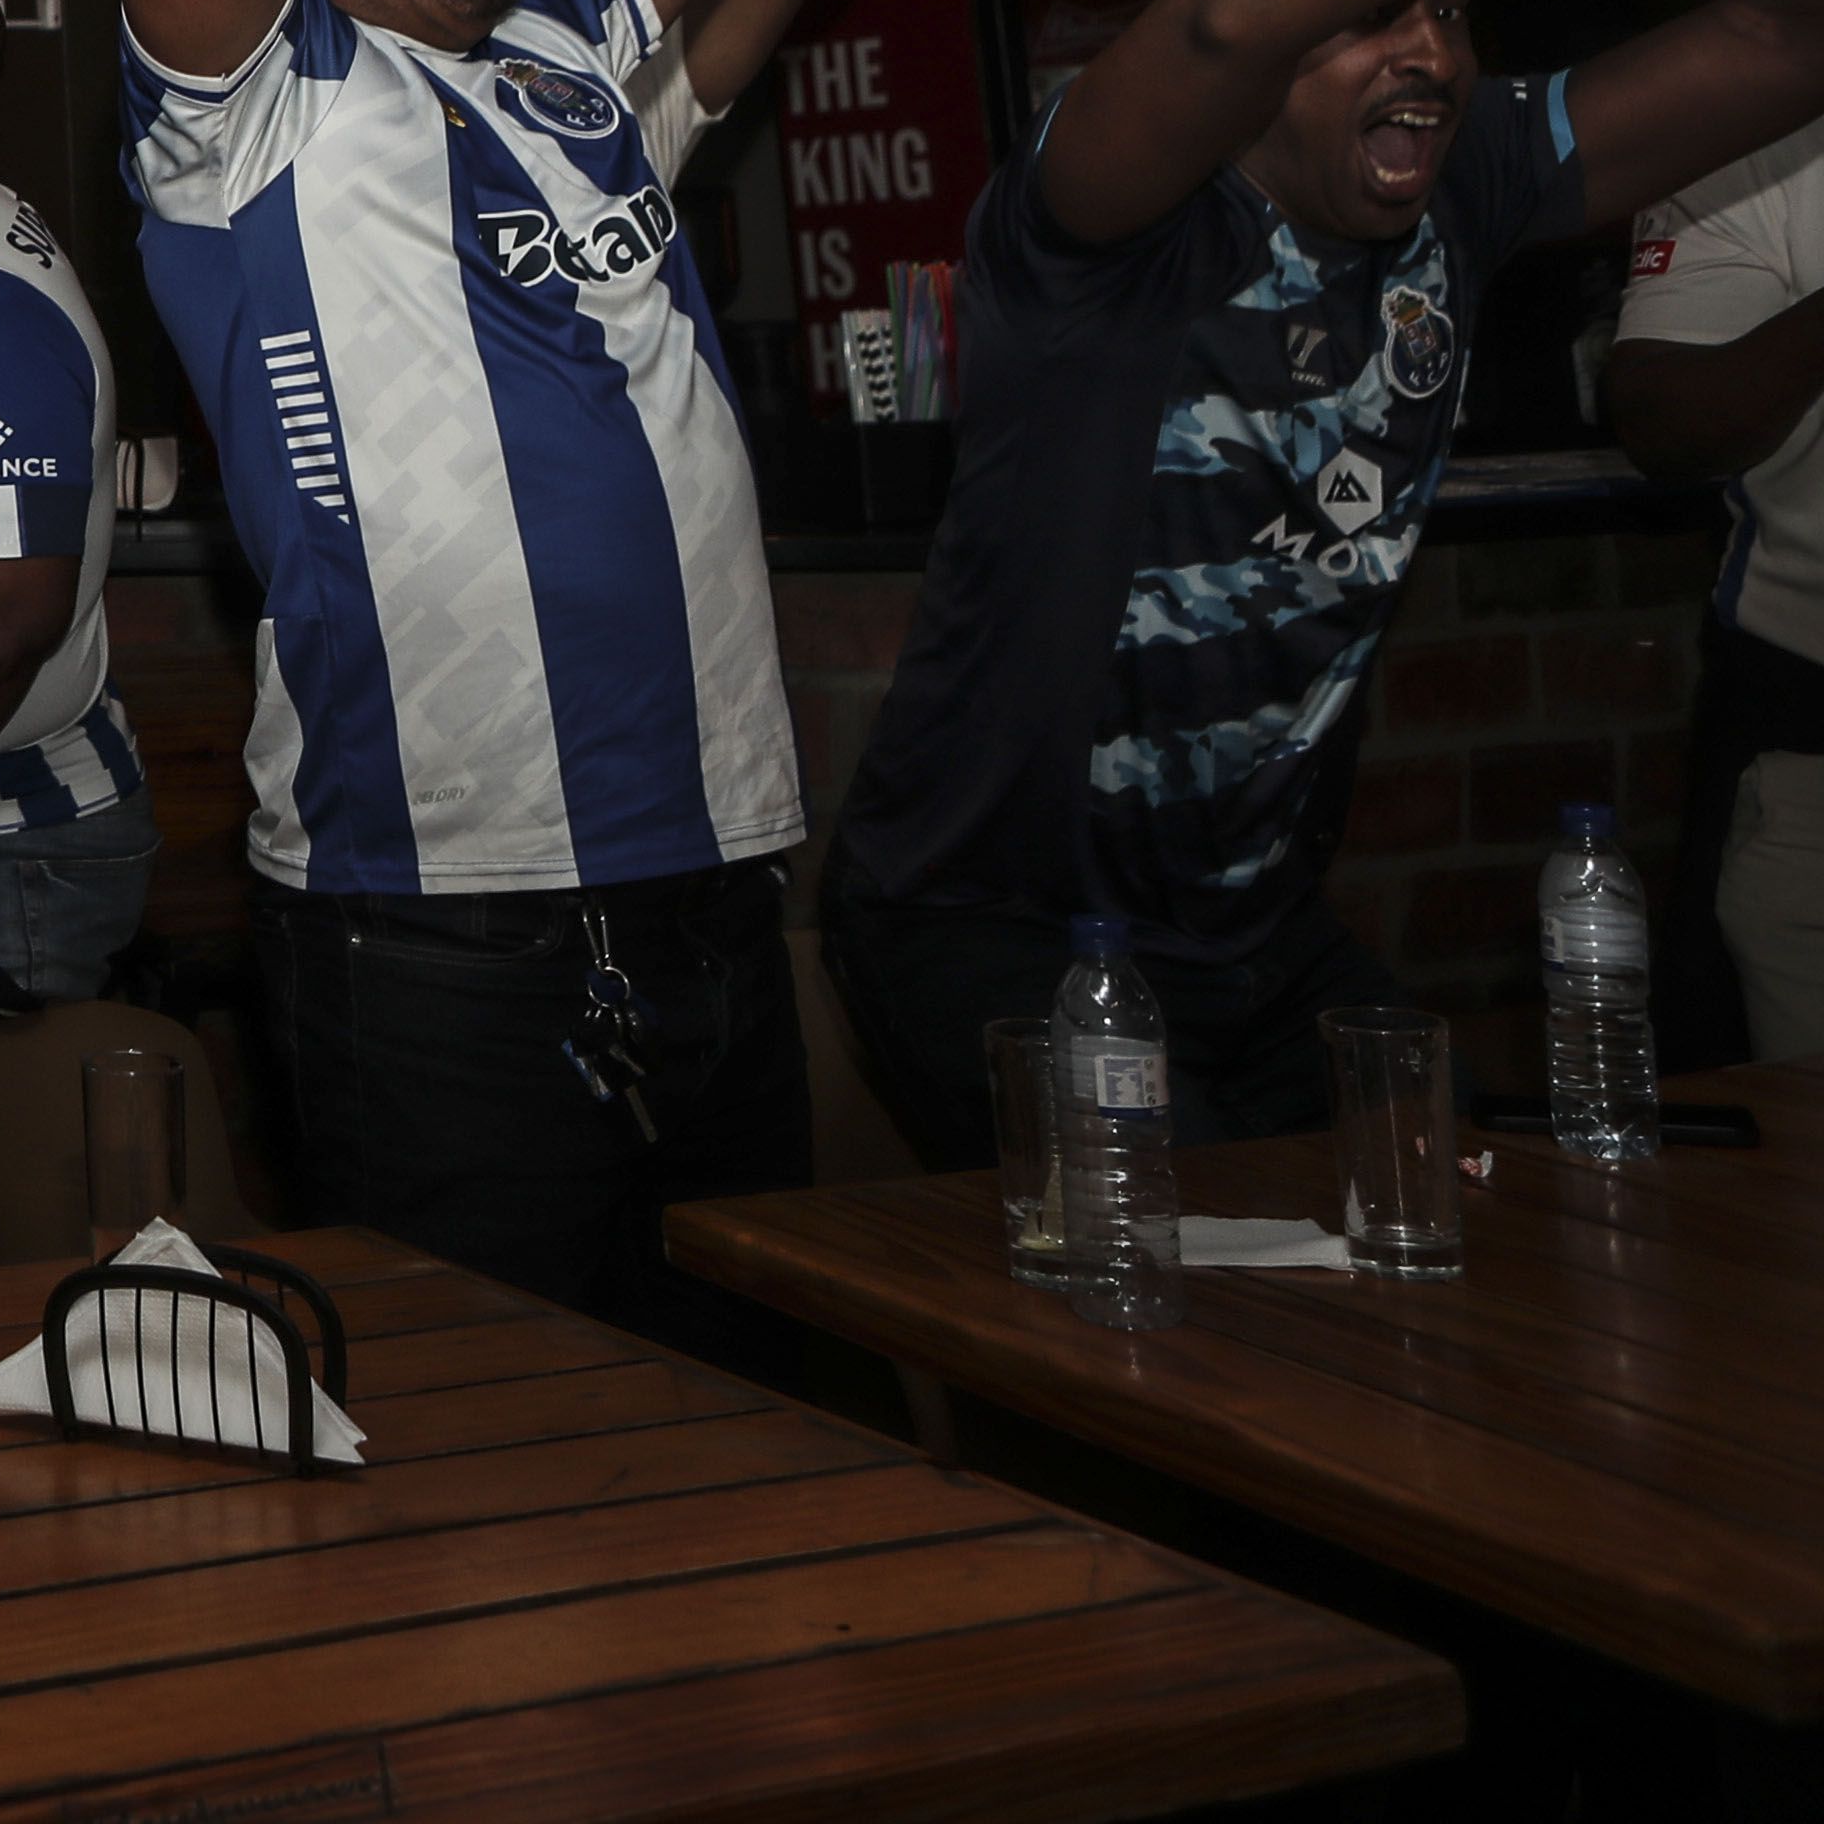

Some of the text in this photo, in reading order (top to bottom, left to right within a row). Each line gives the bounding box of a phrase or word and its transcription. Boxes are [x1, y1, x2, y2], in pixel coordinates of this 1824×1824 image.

[779, 38, 889, 117] THE
[789, 127, 935, 209] KING
[798, 227, 857, 303] IS
